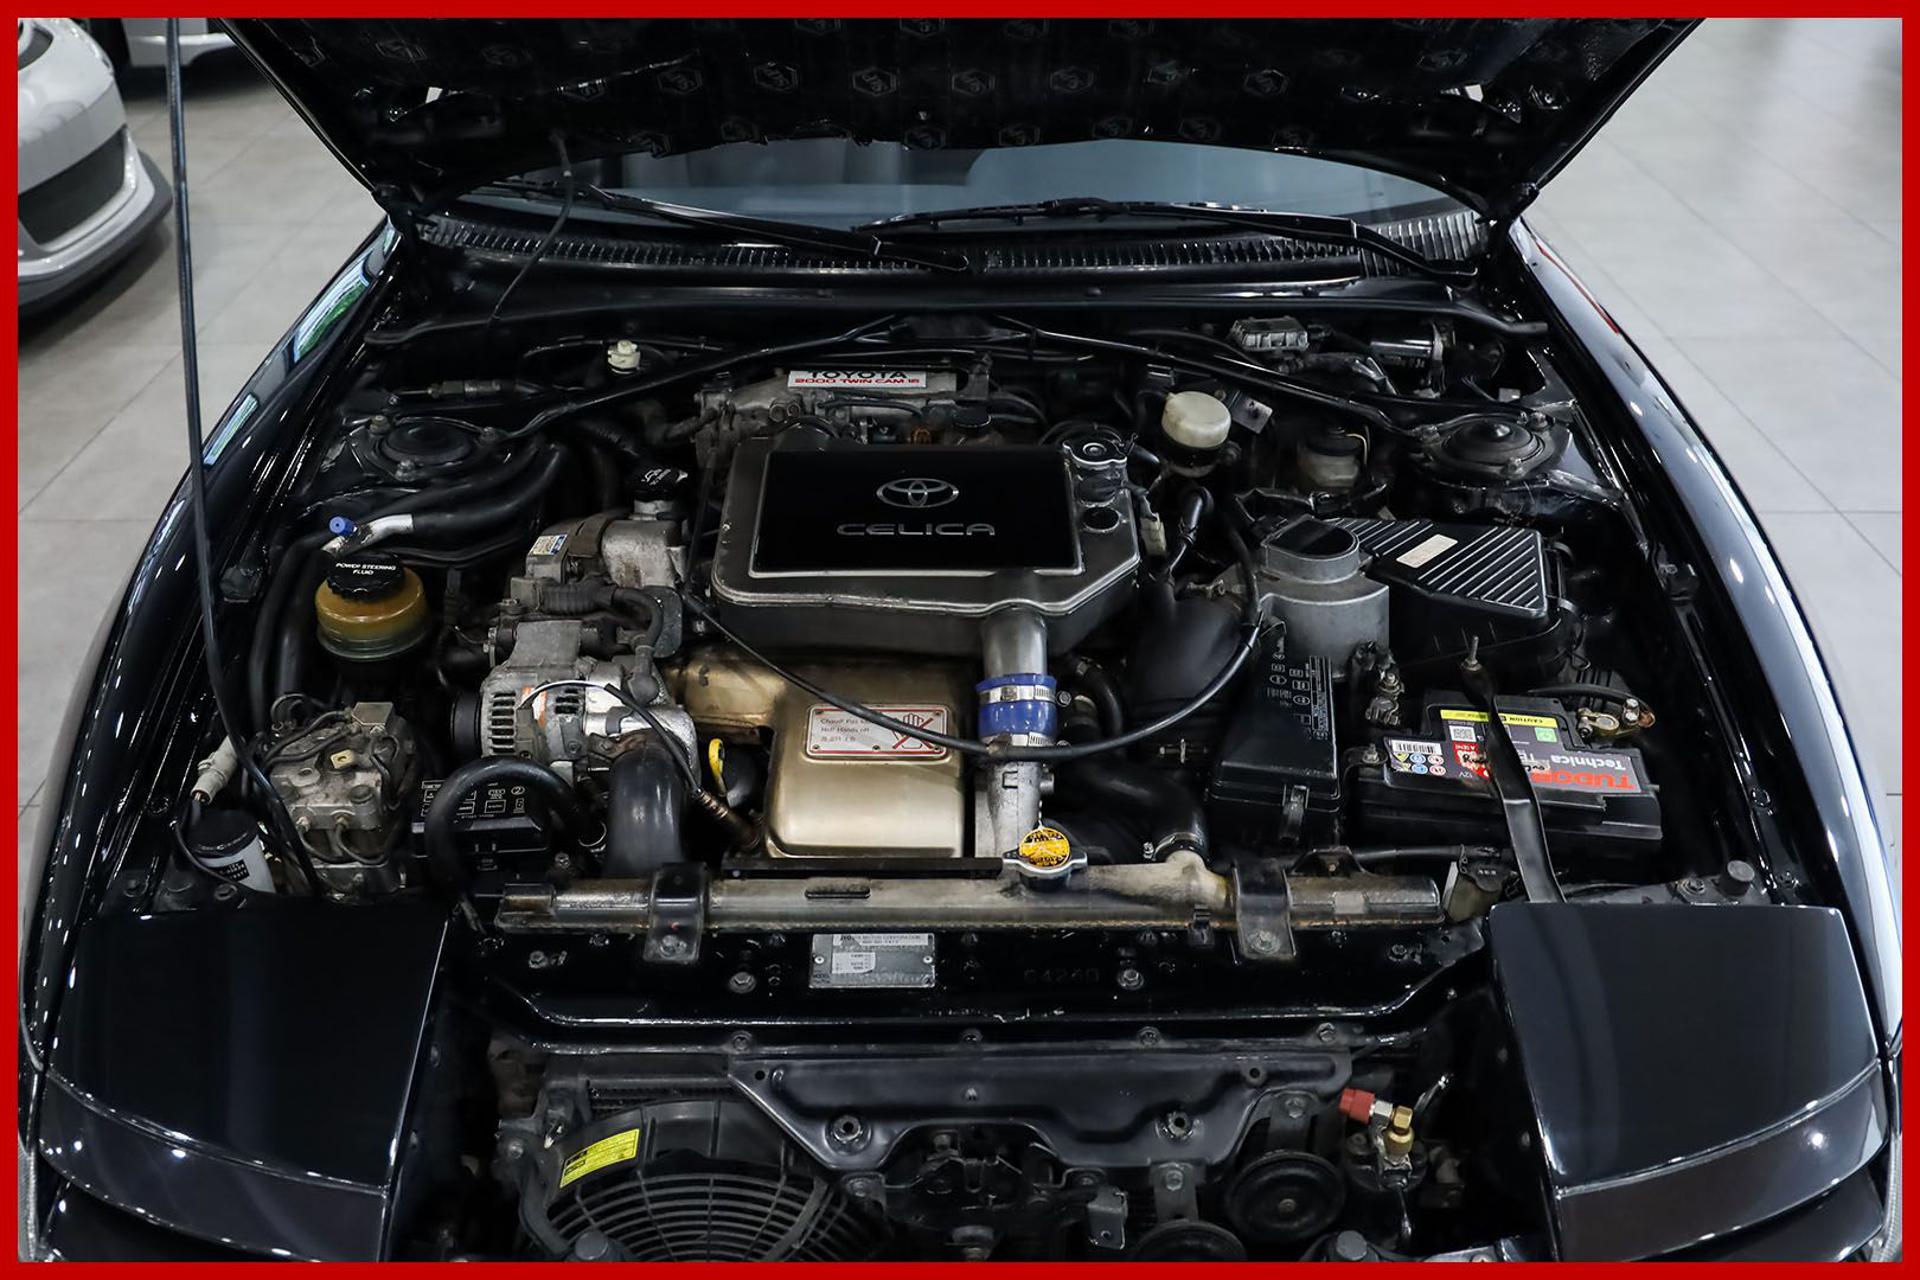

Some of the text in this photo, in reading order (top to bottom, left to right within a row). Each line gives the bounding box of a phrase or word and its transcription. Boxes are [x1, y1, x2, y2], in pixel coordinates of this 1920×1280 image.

[808, 370, 907, 379] TOYOTA
[836, 523, 995, 536] CELICA
[1550, 754, 1626, 770] Technica
[1530, 769, 1637, 789] TUDOR
